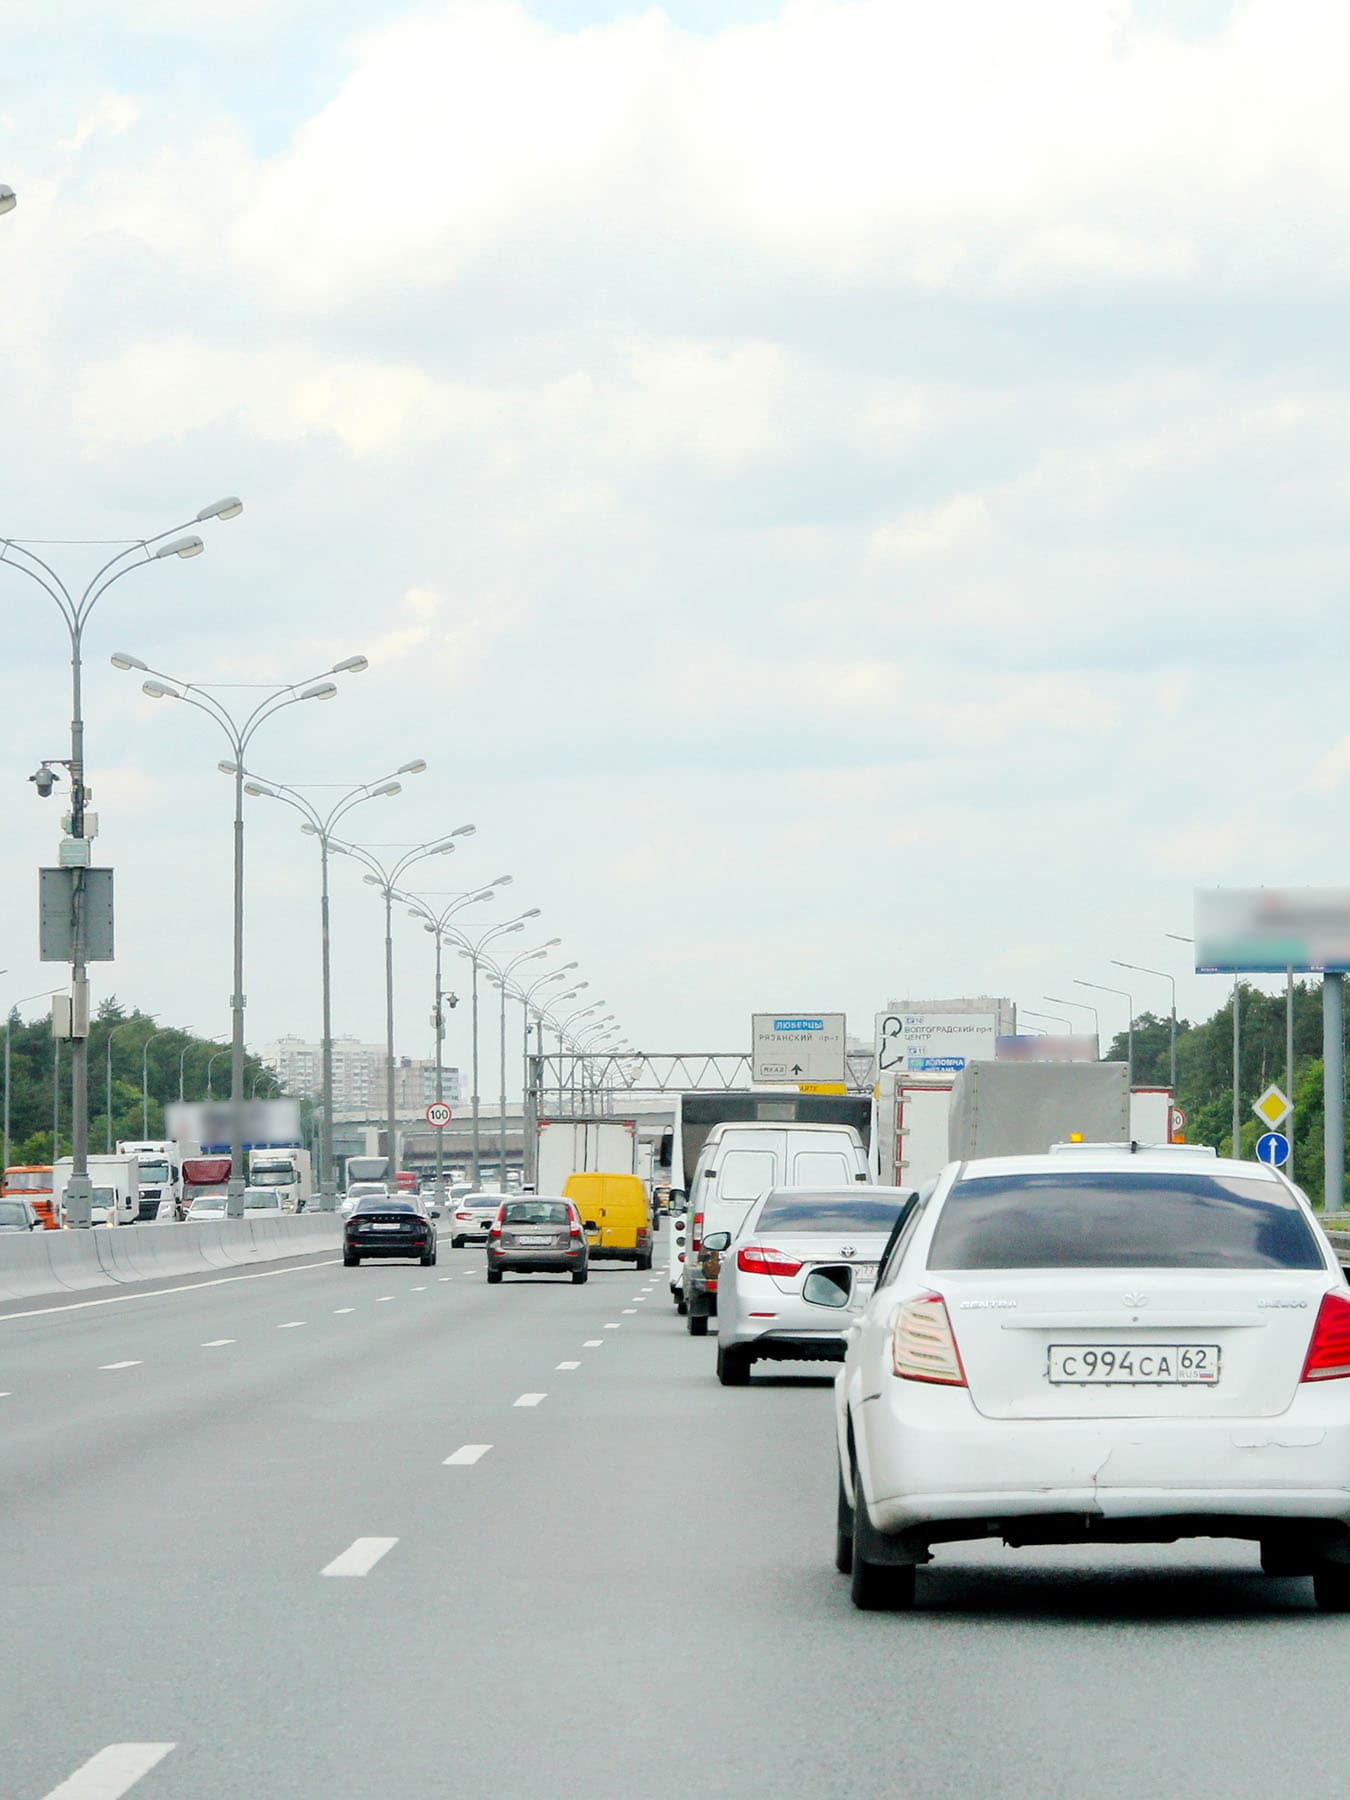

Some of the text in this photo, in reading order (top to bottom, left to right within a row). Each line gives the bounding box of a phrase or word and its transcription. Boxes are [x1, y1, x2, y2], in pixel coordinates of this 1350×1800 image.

[775, 1020, 822, 1030] ЛЮБЕРЦЫ
[904, 1025, 975, 1034] ВОЛГОГРАДСКИЙ
[759, 1033, 813, 1041] РЯЗАНСКИЙ
[430, 1109, 449, 1120] 100
[1062, 1349, 1207, 1377] С994СА 62
[1179, 1370, 1199, 1379] RUS
